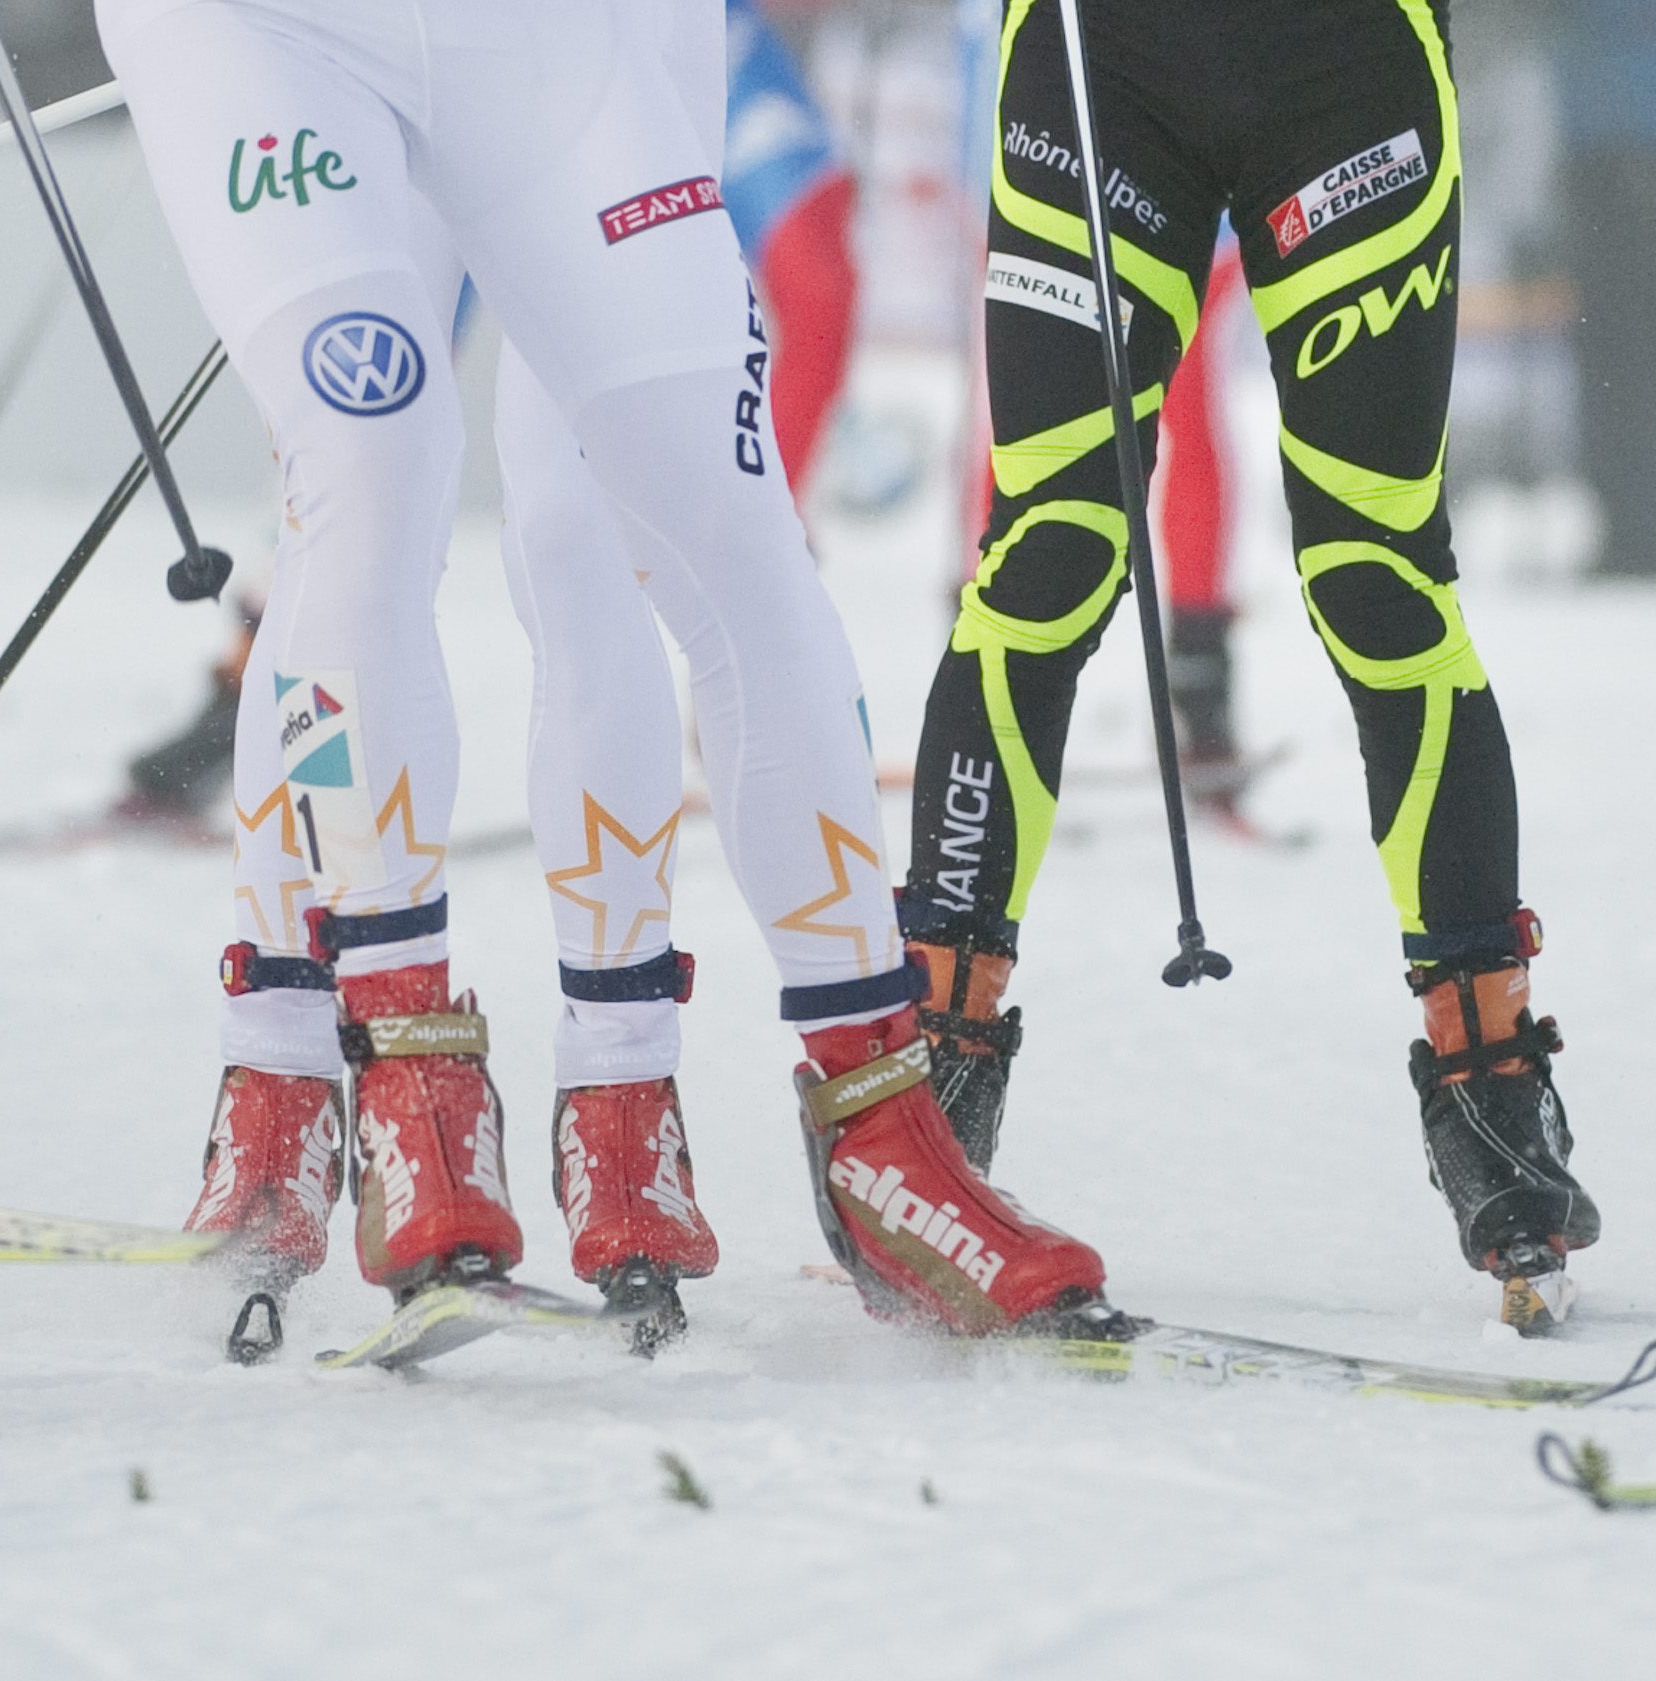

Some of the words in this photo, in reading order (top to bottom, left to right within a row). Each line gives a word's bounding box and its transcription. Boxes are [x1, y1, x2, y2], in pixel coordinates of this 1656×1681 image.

[1003, 120, 1082, 178] Rhône
[1101, 165, 1169, 235] lpes
[1307, 155, 1425, 231] D'EPARGNE
[1323, 144, 1394, 193] CAISSE
[603, 188, 694, 236] TEAM
[988, 269, 1087, 310] ATTENFALL
[933, 750, 994, 915] ANCE
[407, 1023, 477, 1042] alpina
[834, 1065, 906, 1104] alpina
[827, 1155, 1006, 1293] alpina
